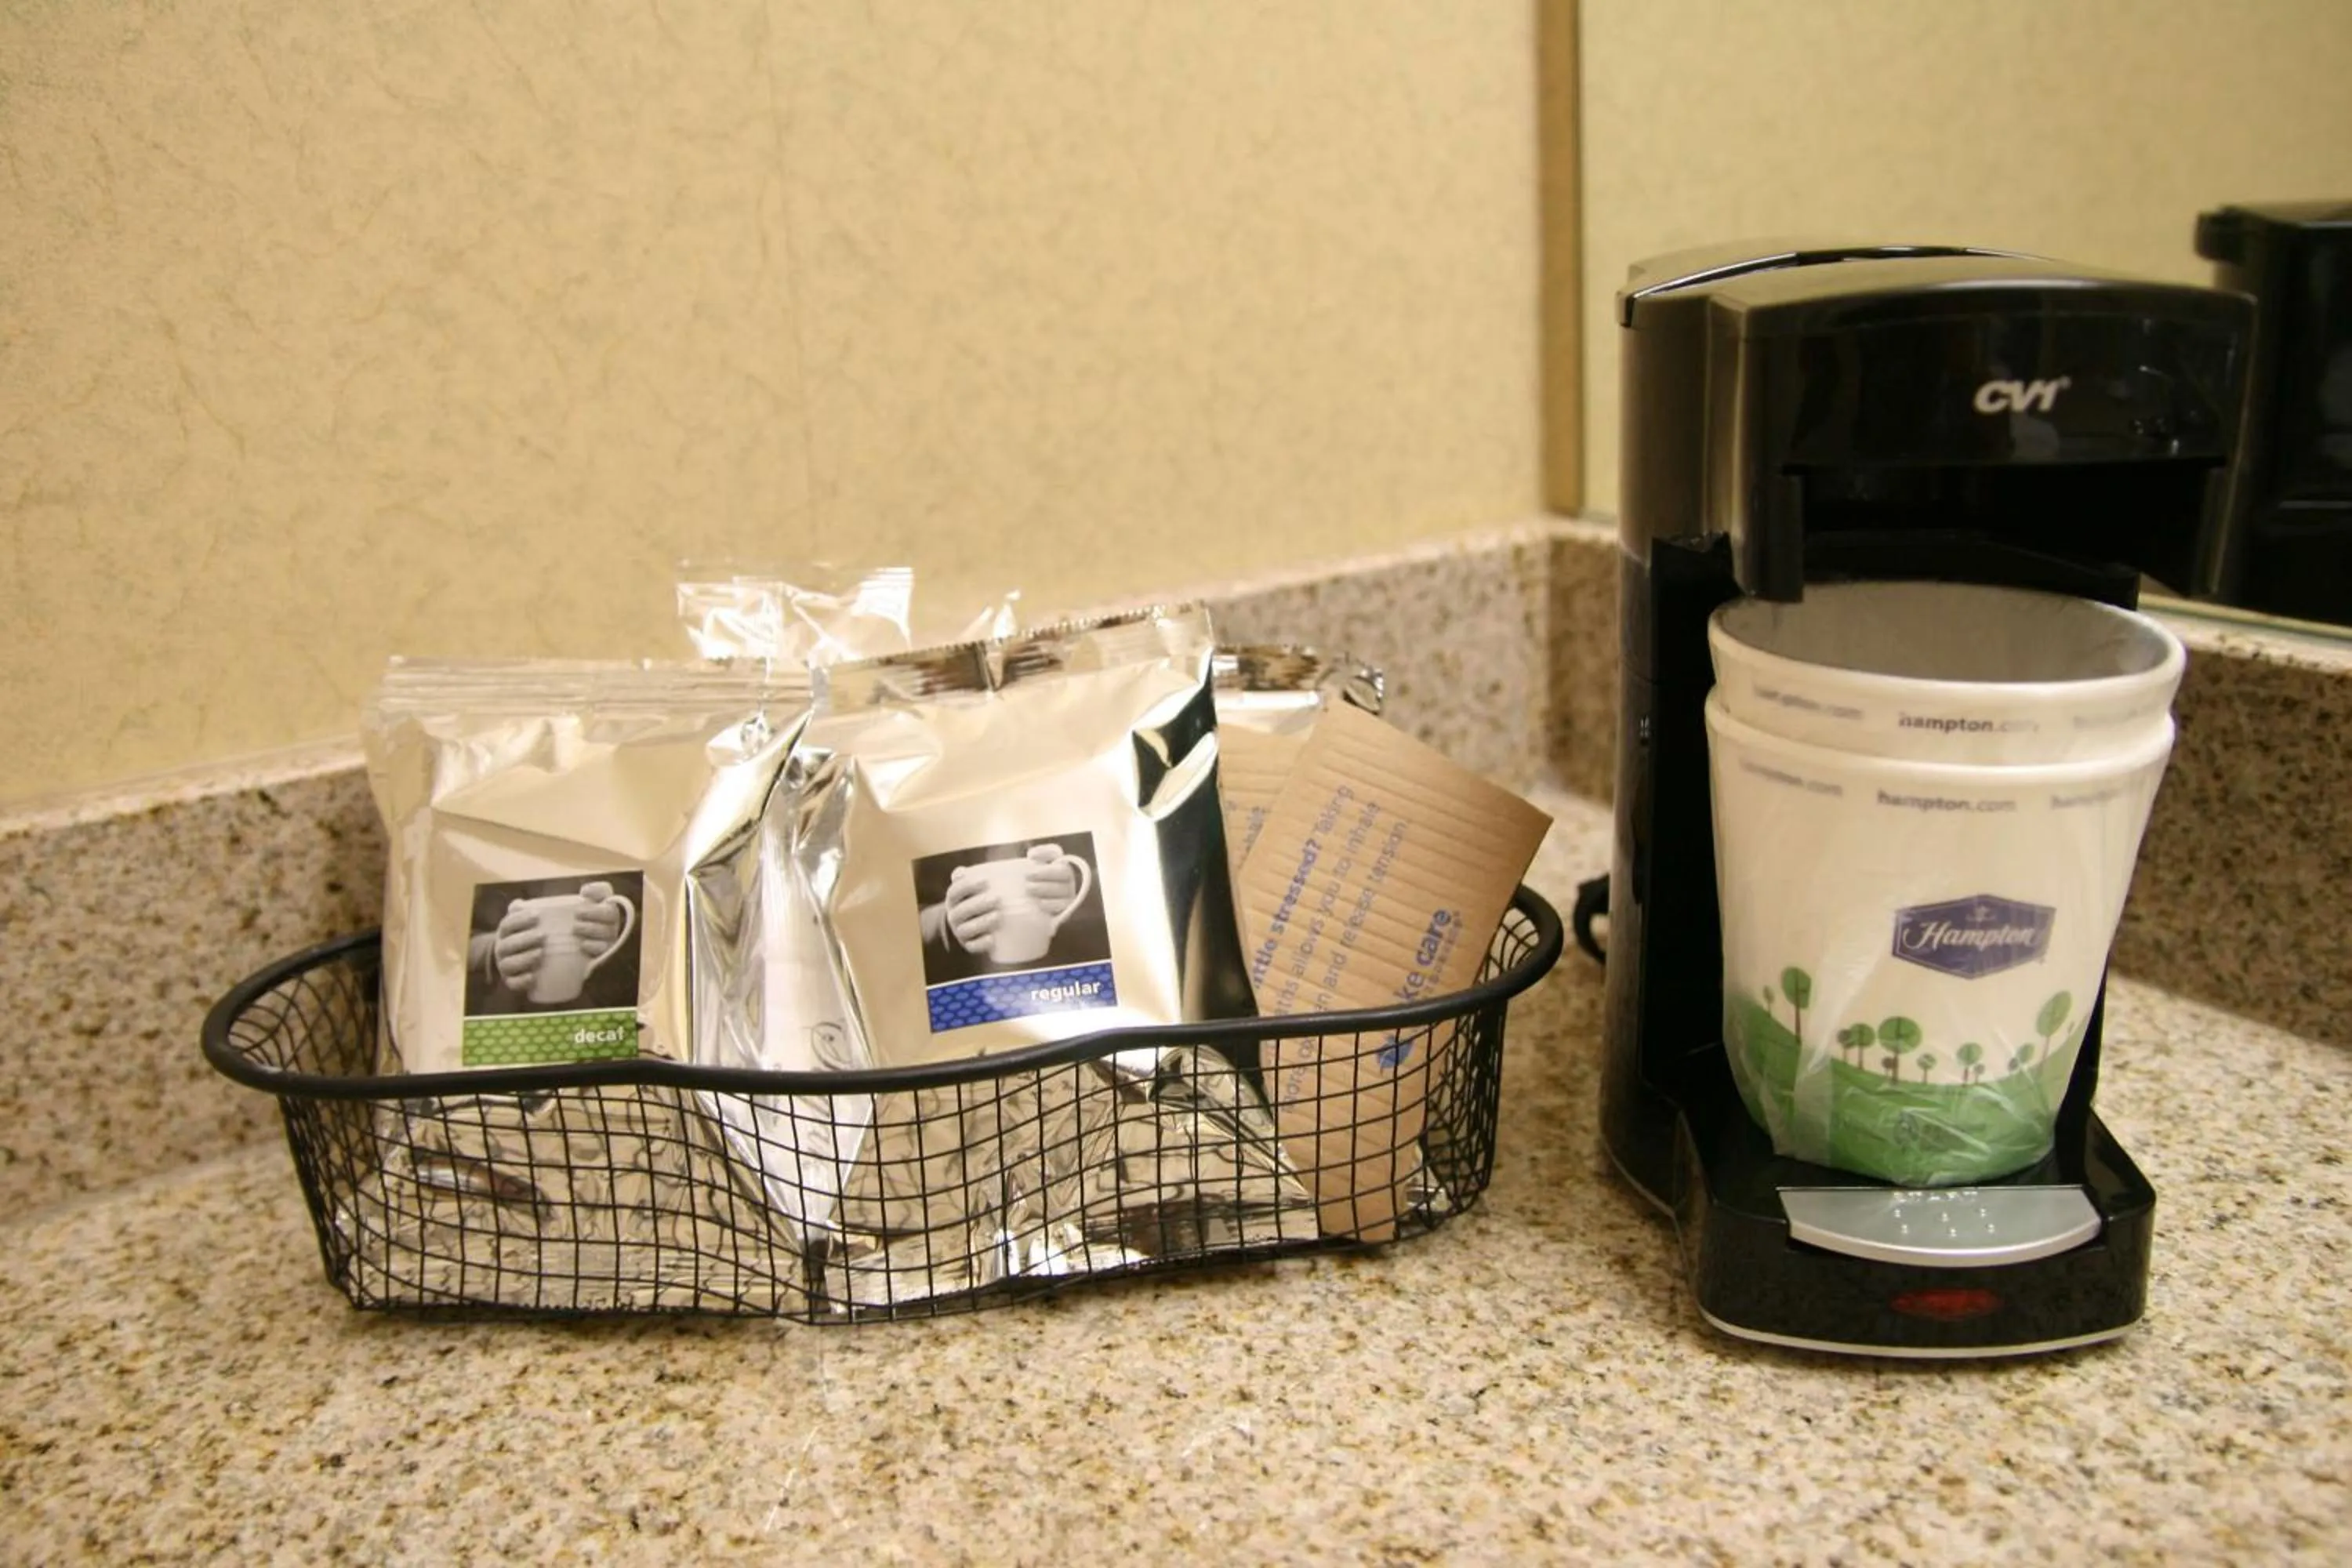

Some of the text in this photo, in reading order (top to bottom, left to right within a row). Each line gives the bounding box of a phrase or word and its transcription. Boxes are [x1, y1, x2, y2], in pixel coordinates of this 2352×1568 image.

[1877, 789, 2016, 811] hampton.com
[1253, 785, 1355, 990] ittle stressed? Taking
[1291, 916, 1325, 978] allows
[1317, 881, 1341, 917] you
[1333, 855, 1352, 879] to
[1345, 801, 1381, 854] inhale
[1323, 950, 1347, 989] and
[1340, 887, 1376, 948] release
[1392, 971, 1425, 1000] ke
[1415, 909, 1452, 967] care
[1902, 920, 2036, 952] Hampton
[1030, 981, 1102, 1003] regular
[575, 1025, 625, 1044] decaf
